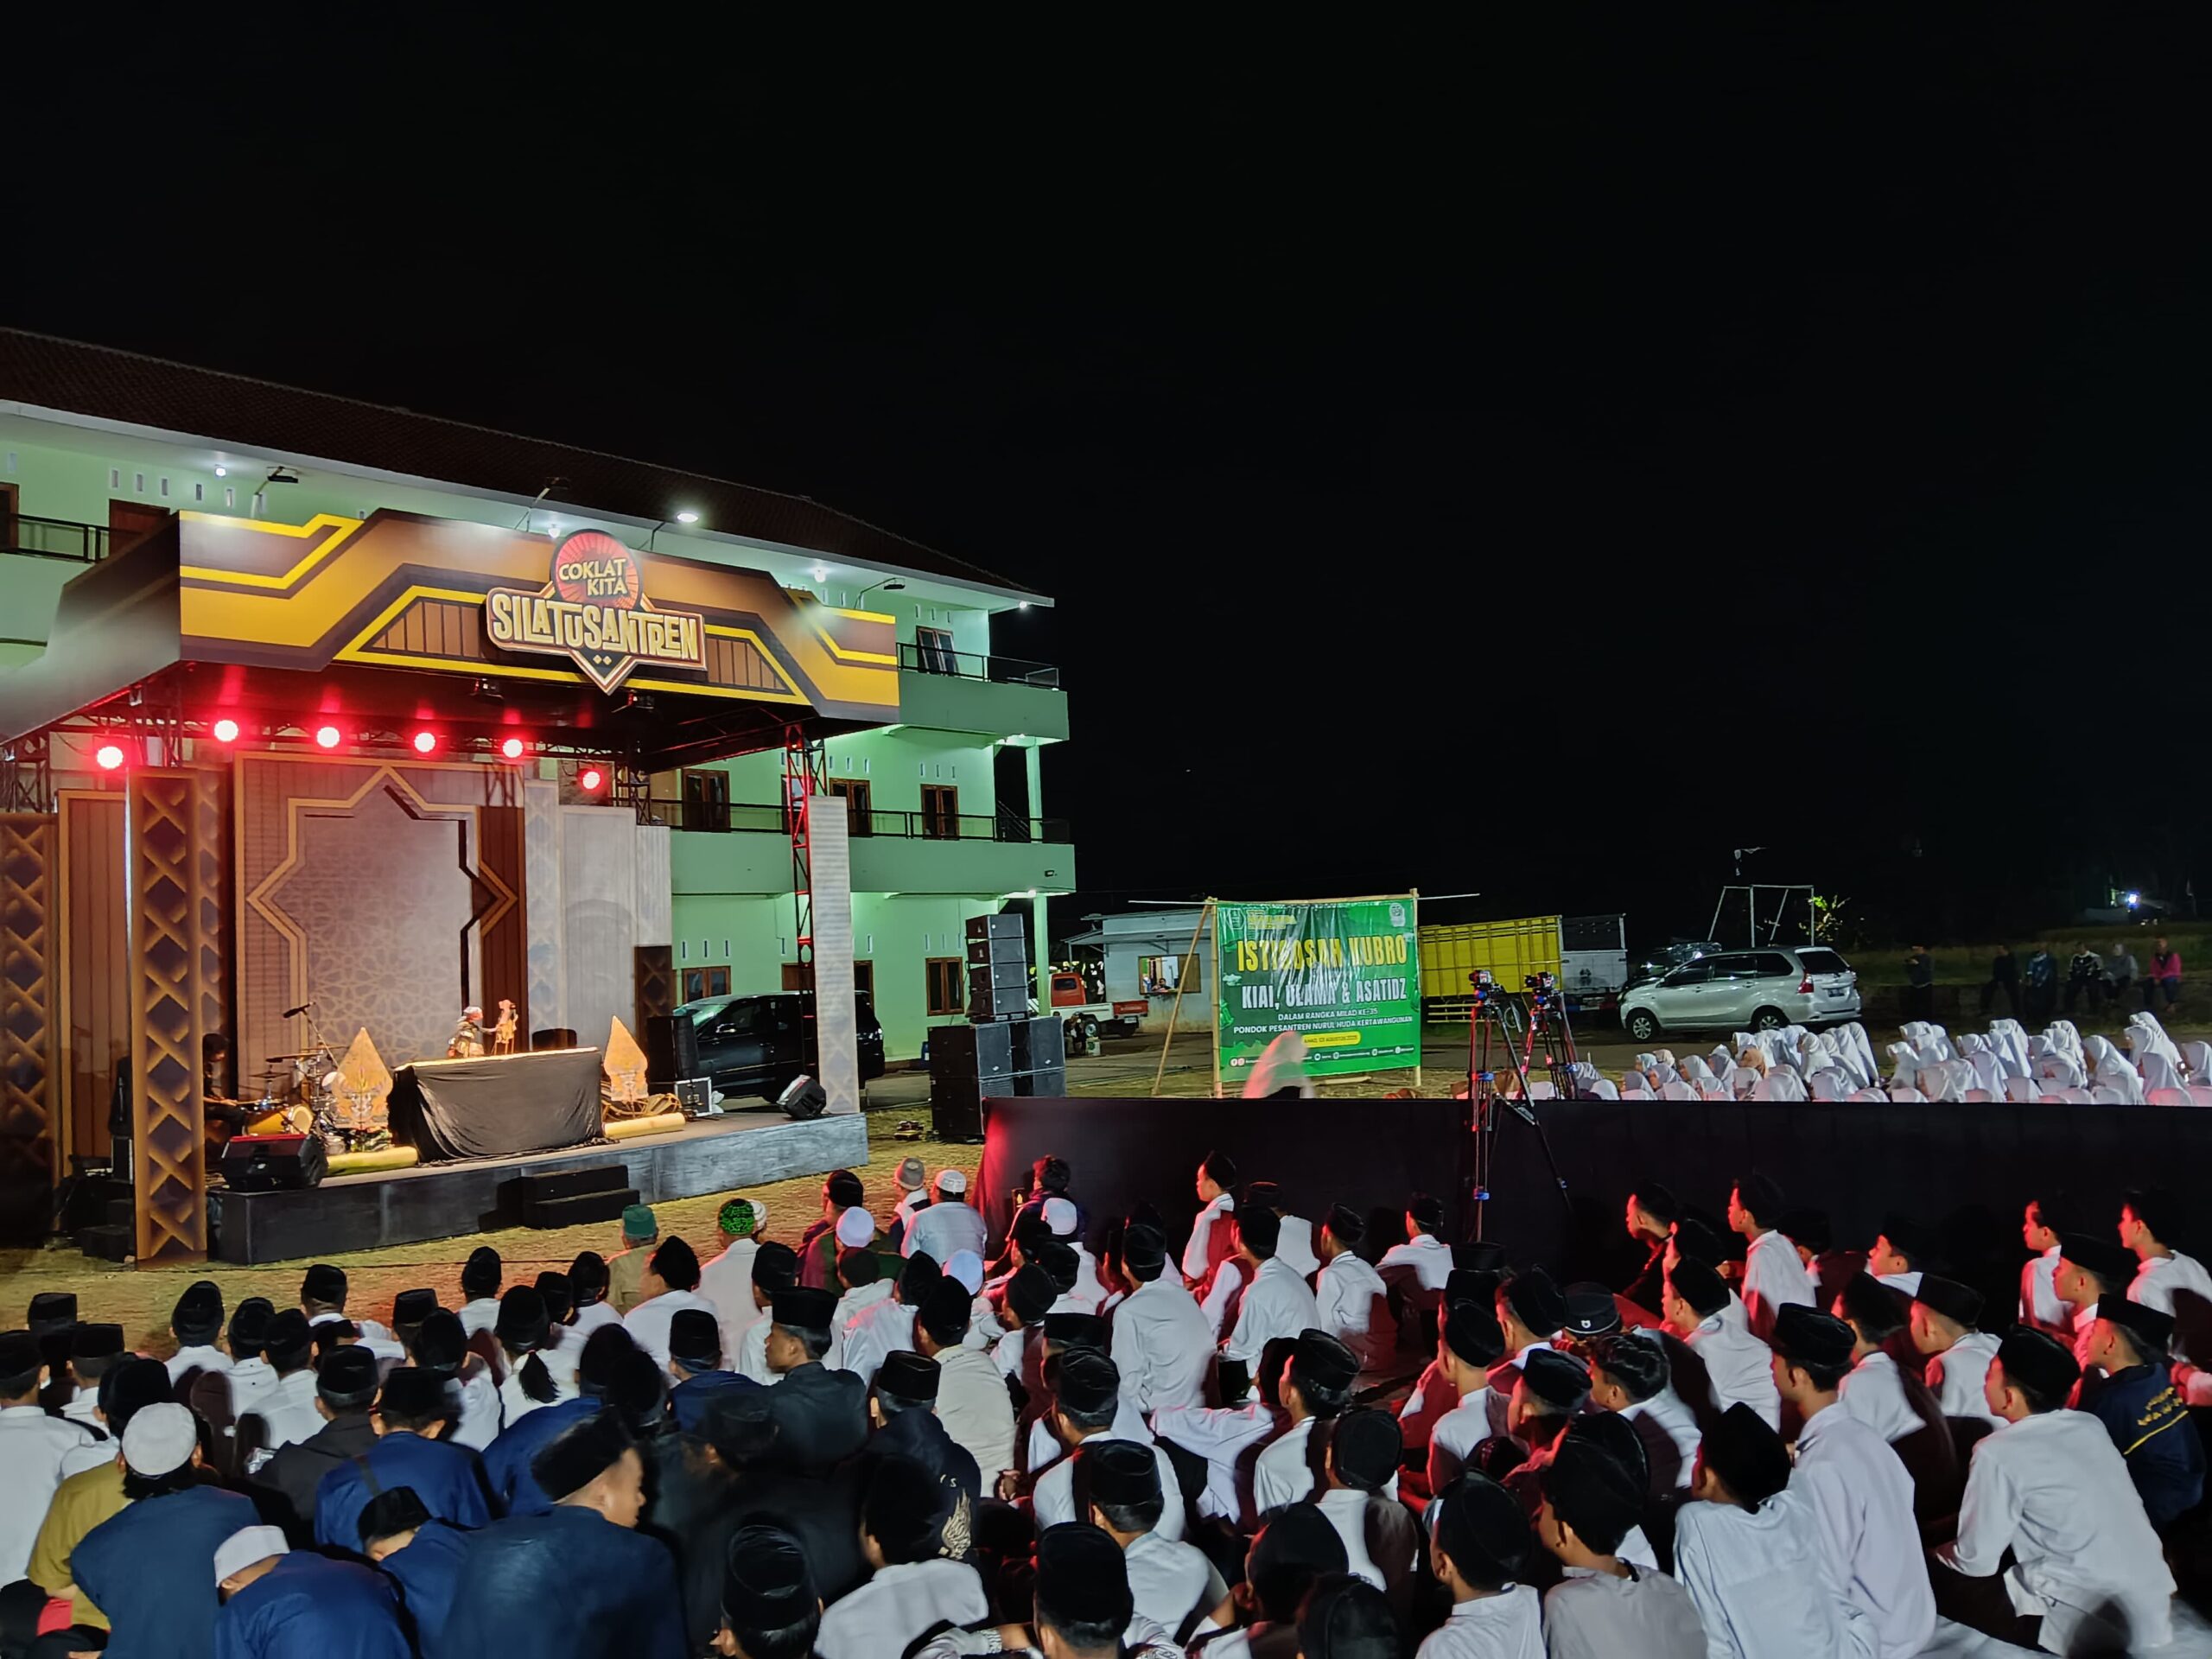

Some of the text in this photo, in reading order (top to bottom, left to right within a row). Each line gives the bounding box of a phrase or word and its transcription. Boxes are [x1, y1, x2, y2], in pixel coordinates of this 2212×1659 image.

[558, 557, 628, 582] COKLAT
[587, 579, 628, 596] KITA
[492, 593, 698, 661] SILATUSANTREN
[1348, 935, 1407, 966] KUBRO
[1242, 977, 1407, 1010] KIAI, ULAMA & ASATIDZ
[1268, 1023, 1311, 1032] PESANTREN
[1305, 1011, 1336, 1020] RANGKA
